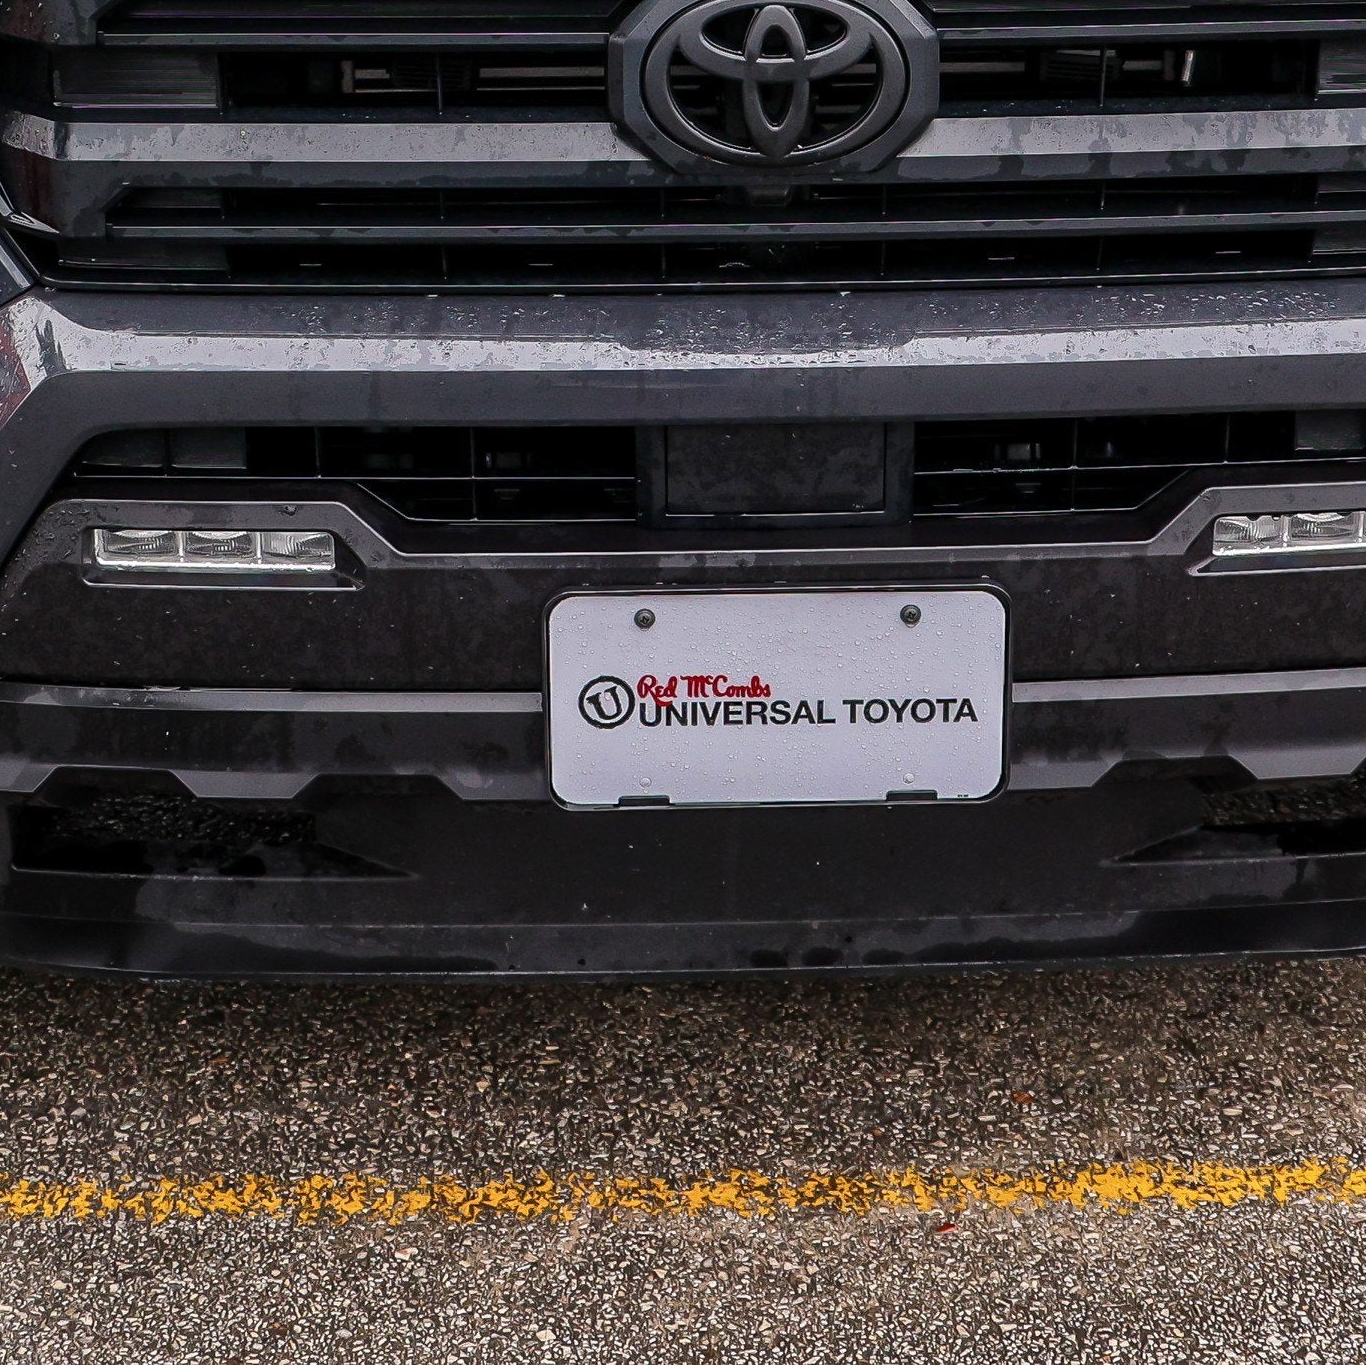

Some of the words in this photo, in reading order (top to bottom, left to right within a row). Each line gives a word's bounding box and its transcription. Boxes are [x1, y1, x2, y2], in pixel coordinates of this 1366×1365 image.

[637, 675, 678, 706] Red
[680, 675, 772, 698] McCombs
[639, 698, 837, 727] UNIVERSAL
[843, 697, 978, 724] TOYOTA
